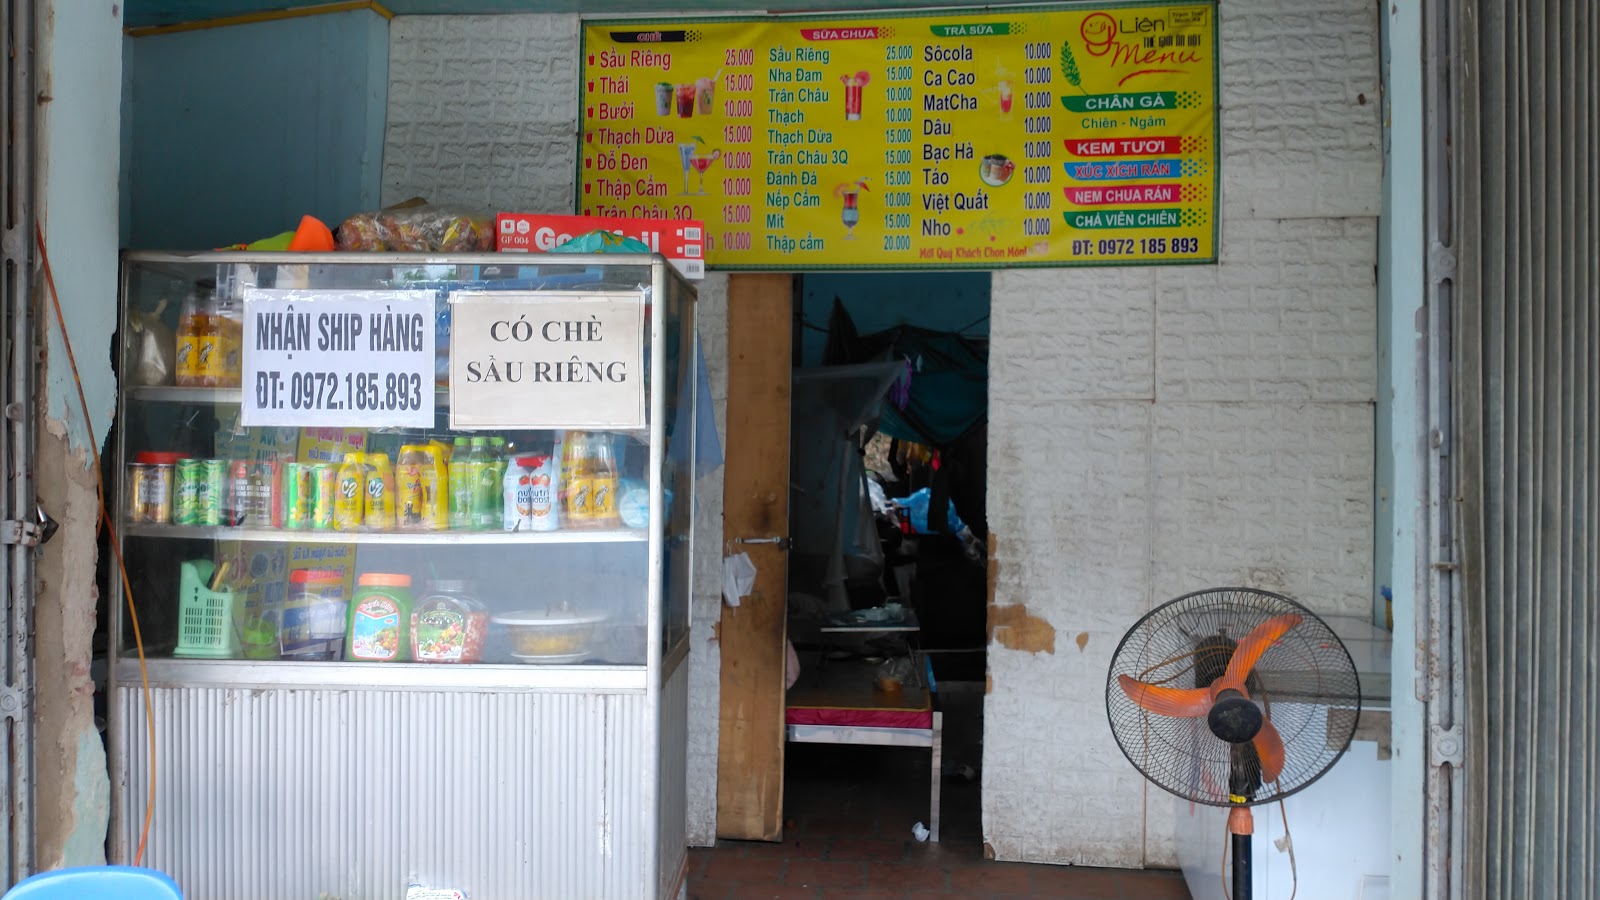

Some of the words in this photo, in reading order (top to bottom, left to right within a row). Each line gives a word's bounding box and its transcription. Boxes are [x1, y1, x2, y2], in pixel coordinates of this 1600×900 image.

[813, 28, 839, 40] SỮA
[841, 28, 875, 39] CHUA
[944, 25, 966, 36] TRÀ
[969, 24, 994, 35] SỮA
[1119, 17, 1165, 33] Liên
[631, 49, 671, 71] Riêng
[725, 49, 754, 66] 25.000
[795, 47, 830, 65] Riêng
[886, 45, 913, 60] 25.000
[923, 44, 973, 62] Sôcola
[1024, 42, 1052, 60] 10.000
[1110, 42, 1203, 68] Menu
[768, 68, 792, 82] Nha
[795, 68, 822, 82] Đam
[886, 66, 912, 81] 15.000
[923, 70, 942, 86] Ca
[947, 69, 975, 85] Cao
[1024, 67, 1052, 84] 10.000
[599, 76, 629, 94] Thái
[725, 74, 753, 91] 15.000
[768, 88, 794, 103] Trân
[798, 87, 829, 103] Châu
[886, 87, 912, 101] 10.000
[923, 93, 978, 111] MatCha
[1024, 92, 1052, 109] 10.000
[1085, 94, 1134, 110] CHÂN
[1139, 92, 1165, 108] GÀ
[599, 101, 635, 120] Bưởi
[724, 100, 753, 117] 10.000
[768, 108, 804, 126] Thạch
[885, 108, 912, 122] 10.000
[923, 118, 951, 136] Dâu
[1024, 116, 1051, 133] 10.000
[1081, 116, 1118, 129] Chiên
[1129, 114, 1166, 130] Ngâm
[598, 127, 641, 149] Thạch
[723, 125, 752, 143] 15.000
[767, 128, 804, 147] Thạch
[885, 128, 912, 143] 15.000
[923, 144, 950, 164] Bạc
[955, 142, 974, 159] Hà
[1024, 141, 1051, 158] 10.000
[1077, 141, 1115, 155] KEM
[1120, 139, 1165, 153] TƯƠI
[597, 150, 616, 171] Đỗ
[621, 152, 648, 171] Đen
[723, 151, 752, 169] 10.000
[767, 150, 793, 165] Trân
[797, 149, 828, 165] Châu
[831, 149, 848, 165] 3Q
[885, 149, 911, 164] 15.000
[766, 170, 798, 186] Đánh
[801, 170, 817, 186] Đá
[885, 170, 911, 185] 15.000
[922, 168, 949, 185] Táo
[1024, 166, 1051, 183] 10.000
[1075, 162, 1102, 178] XÚC
[1105, 161, 1138, 178] XÍCH
[1141, 160, 1171, 176] RÁN
[597, 178, 632, 201] Thập
[722, 178, 751, 196] 10.000
[766, 188, 790, 210] Nếp
[884, 192, 911, 207] 10.000
[1075, 189, 1102, 203] NEM
[1105, 188, 1142, 202] CHUA
[1144, 186, 1171, 201] RÁN
[922, 193, 950, 214] Việt
[953, 188, 989, 211] Quất
[1024, 192, 1051, 209] 10.000
[596, 204, 627, 218] Trân
[632, 204, 669, 220] Châu
[673, 204, 693, 221] 3Q
[722, 204, 751, 223] 15.000
[766, 213, 784, 229] Mít
[884, 213, 911, 229] 15.000
[1075, 212, 1102, 227] CHẢ
[1105, 211, 1134, 226] VIÊN
[1137, 210, 1177, 225] CHIÊN
[922, 218, 951, 236] Nho
[1023, 218, 1051, 235] 10.000
[722, 231, 751, 250] 10.000
[766, 235, 796, 253] Thập
[884, 235, 911, 250] 20.000
[1072, 239, 1094, 255] ĐT:
[1098, 238, 1135, 255] 0972
[1140, 238, 1166, 253] 185
[1171, 237, 1198, 253] 893
[955, 246, 982, 258] Khách
[256, 304, 311, 360] NHẬN
[318, 312, 362, 351] SHIP
[369, 305, 424, 352] HÀNG
[490, 314, 533, 342] CÓ
[541, 314, 603, 342] CHÈ
[466, 354, 524, 383] SẦU
[533, 355, 628, 383] RIÊNG
[256, 370, 284, 409] ĐT:
[290, 371, 422, 411] 0972.185.893
[341, 480, 358, 498] C2
[368, 479, 385, 498] C2
